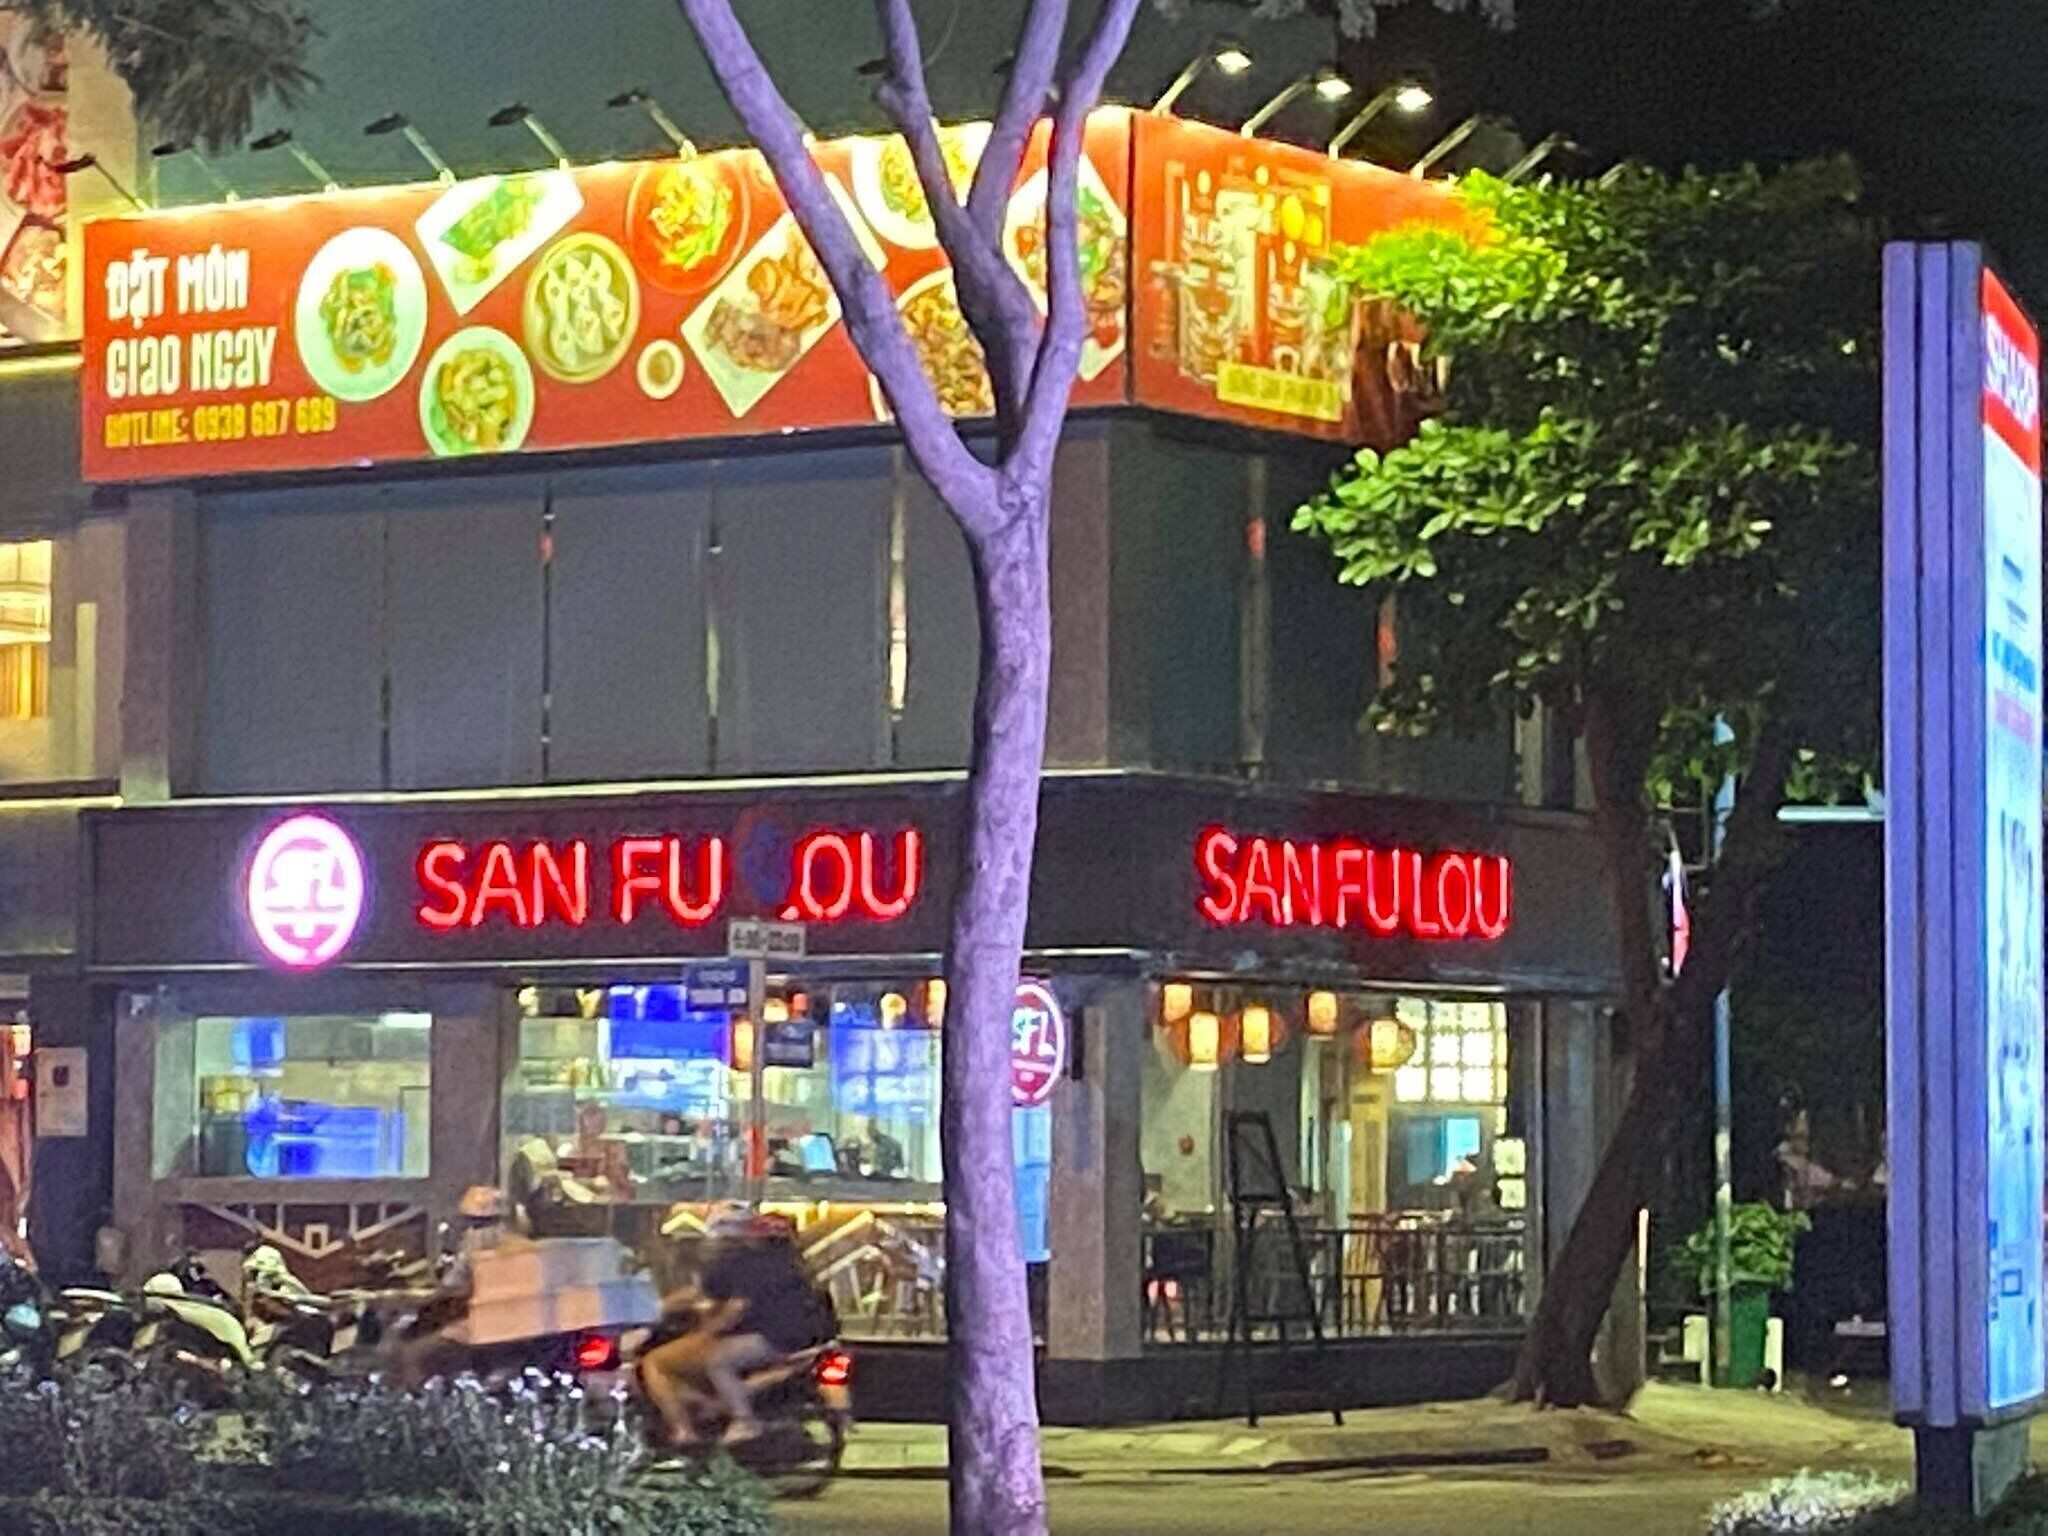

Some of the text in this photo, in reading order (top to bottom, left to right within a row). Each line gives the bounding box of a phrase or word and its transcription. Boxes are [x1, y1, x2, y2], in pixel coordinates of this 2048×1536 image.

[418, 838, 589, 929] SAN
[616, 834, 725, 924] FU
[778, 826, 922, 922] OU
[1200, 830, 1513, 940] SAN FU LOU
